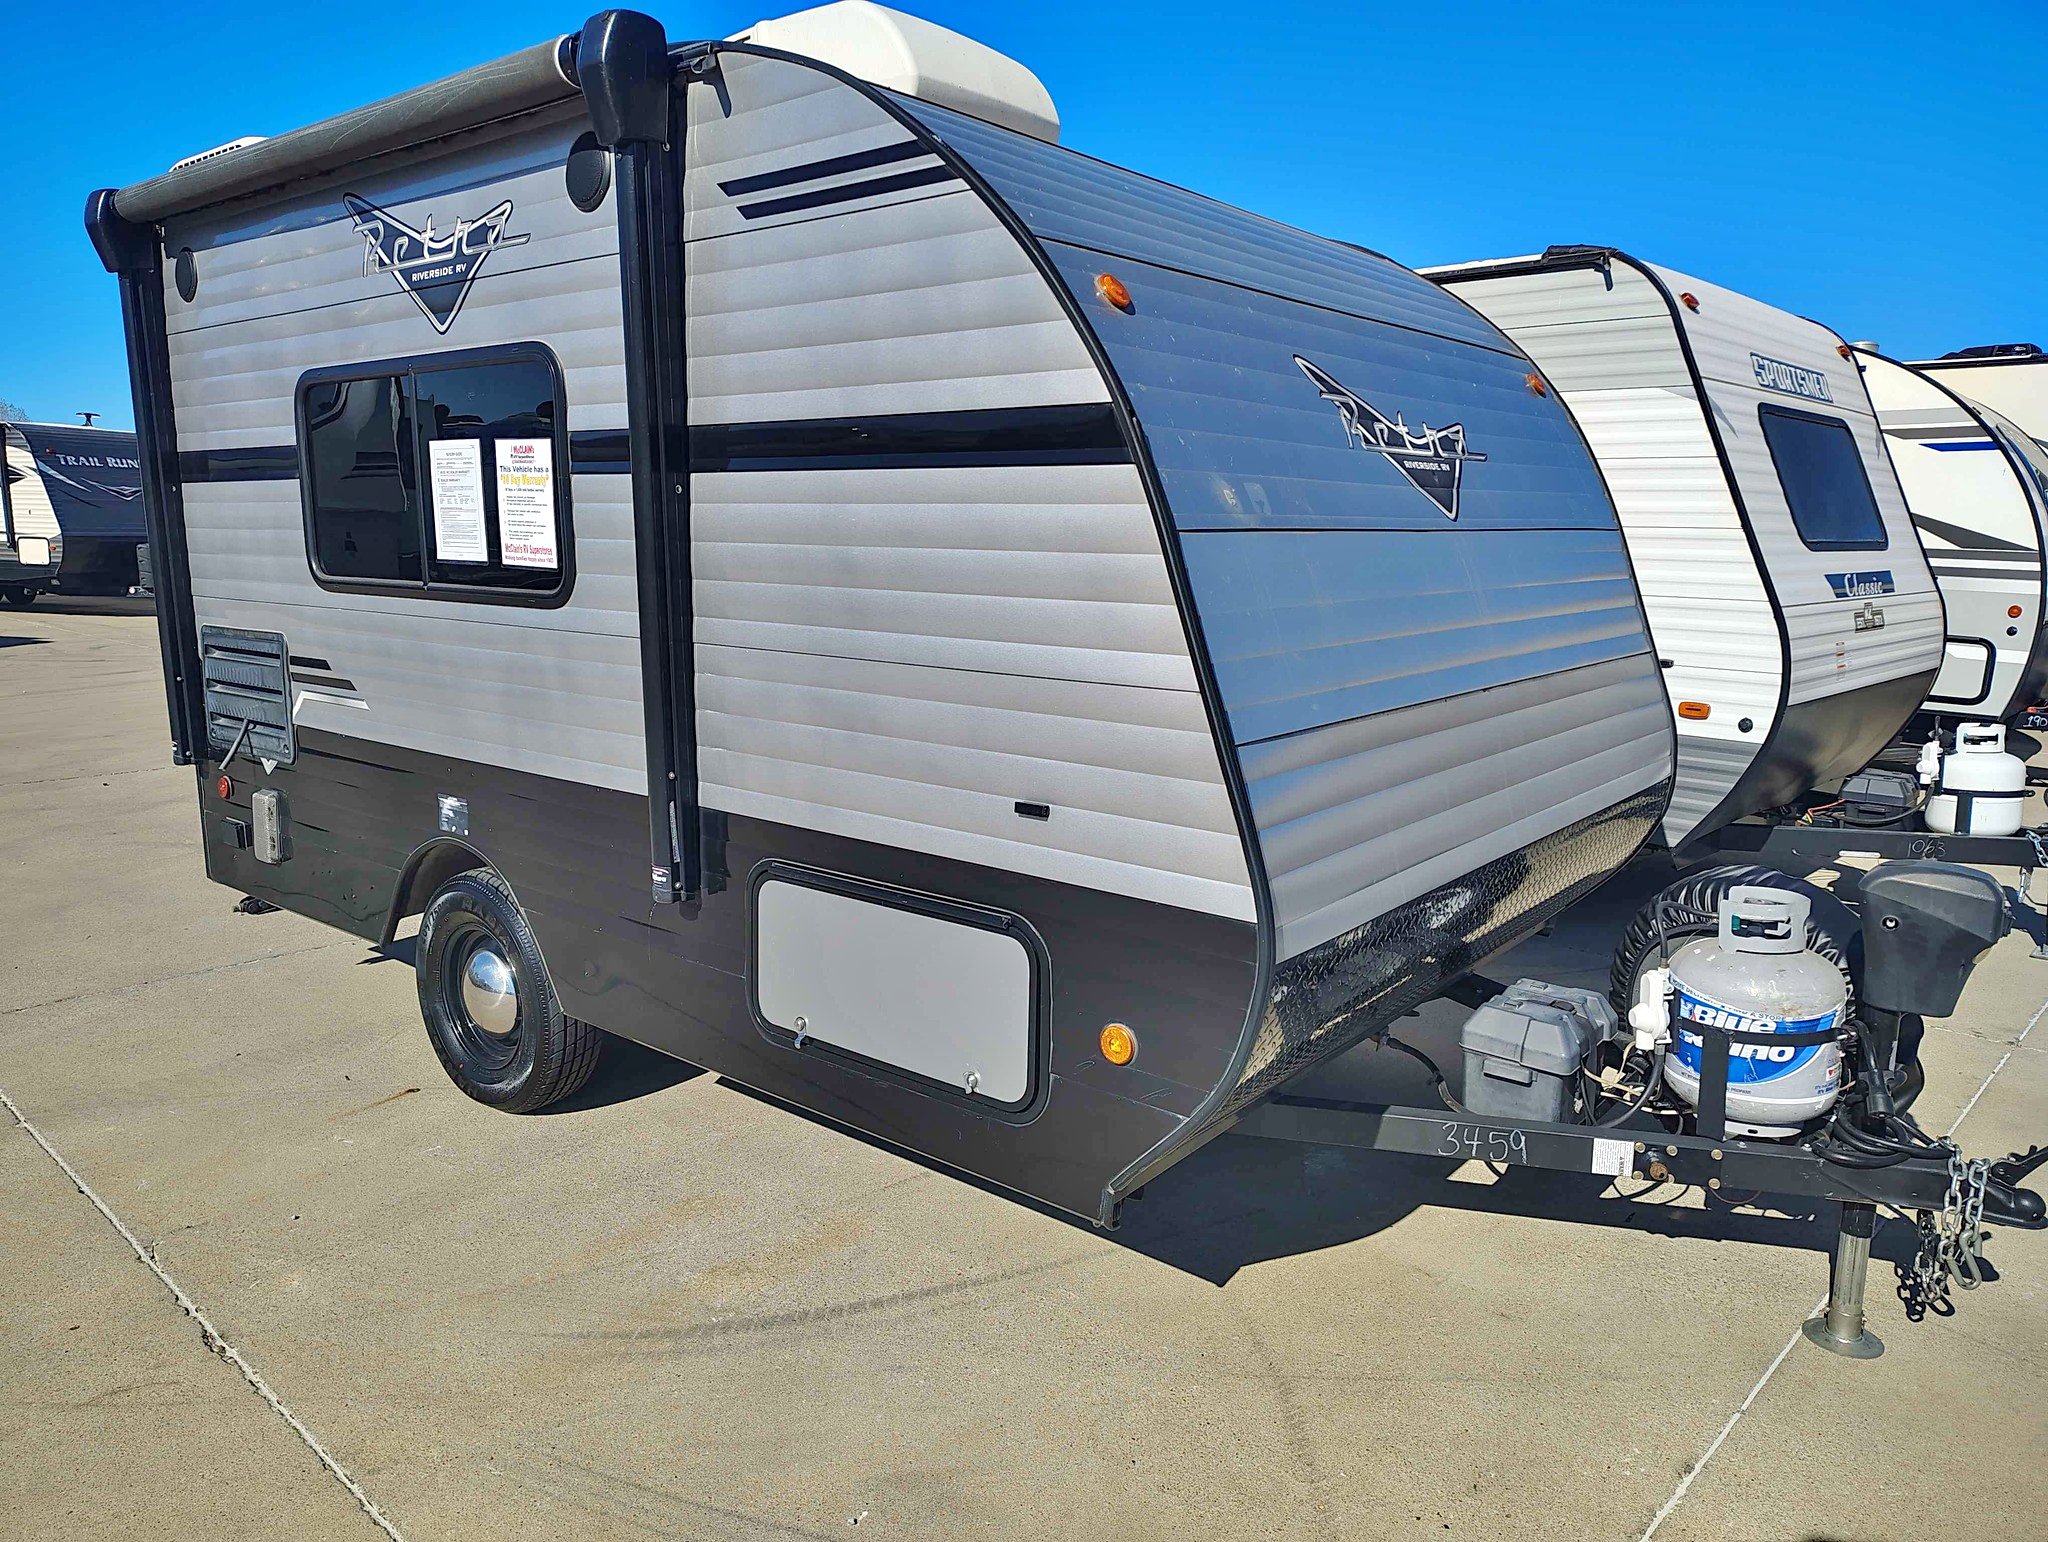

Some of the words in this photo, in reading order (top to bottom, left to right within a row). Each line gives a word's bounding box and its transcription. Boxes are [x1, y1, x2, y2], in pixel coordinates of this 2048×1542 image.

[411, 266, 453, 282] RIVERSIDE
[455, 263, 467, 274] RV
[1750, 355, 1833, 401] SPORTSMEN
[55, 454, 104, 467] TRAIL
[533, 465, 544, 473] has
[1403, 460, 1440, 471] RIVERSIDE
[1440, 463, 1451, 472] RV
[1844, 573, 1884, 597] Classic
[1907, 839, 1946, 861] 1063
[1693, 1004, 1778, 1034] Blue
[1758, 1013, 1787, 1021] STORE
[1437, 1121, 1529, 1166] 3459
